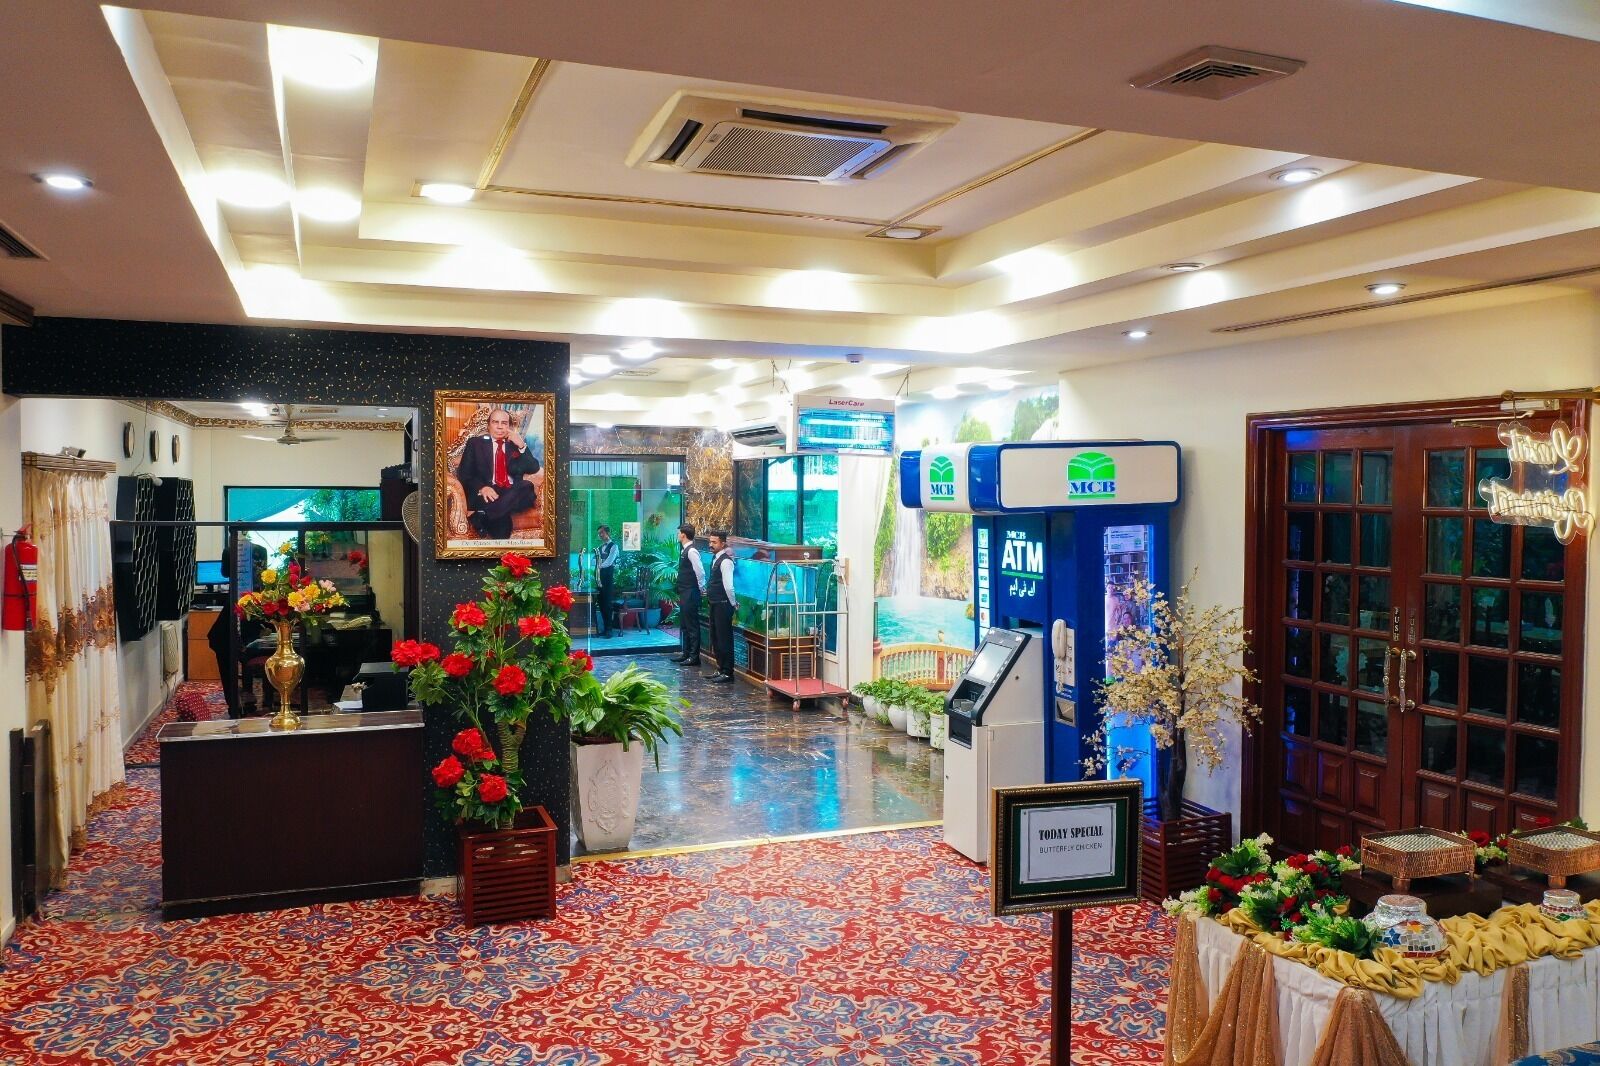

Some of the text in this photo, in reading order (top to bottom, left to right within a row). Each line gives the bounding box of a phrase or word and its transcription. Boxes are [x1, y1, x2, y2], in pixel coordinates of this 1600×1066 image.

[930, 483, 954, 496] MCB
[1069, 481, 1116, 494] MCB
[1006, 530, 1026, 540] MCB
[1001, 539, 1044, 573] ATM
[1038, 825, 1104, 841] TODAY SPECIAL
[1039, 842, 1103, 854] BUTTERFLY CHICKEN
